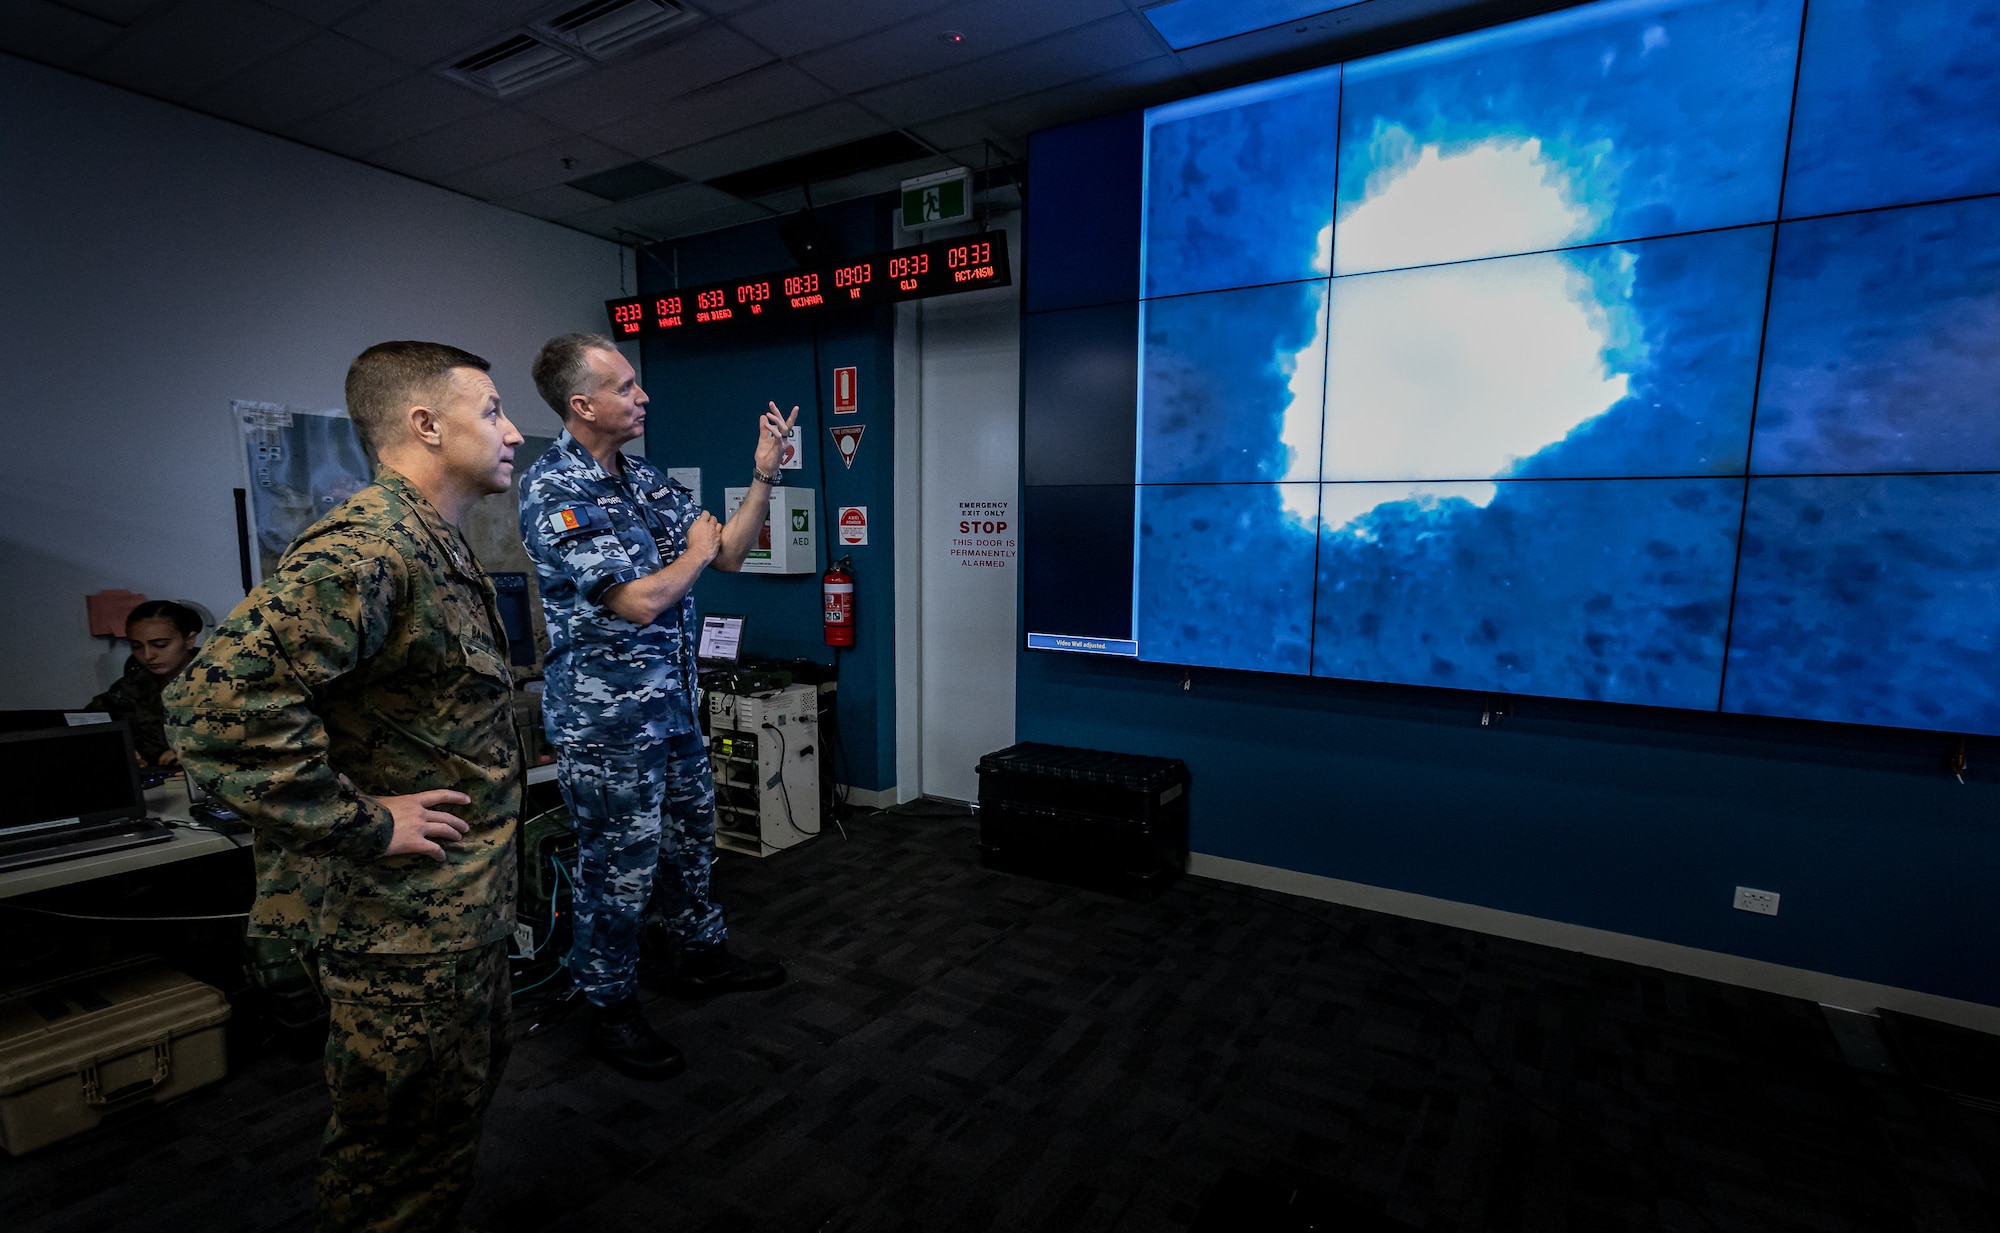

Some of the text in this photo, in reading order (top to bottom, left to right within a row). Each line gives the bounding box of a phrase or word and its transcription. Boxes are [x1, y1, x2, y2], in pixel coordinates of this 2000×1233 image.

[890, 254, 928, 278] 09:33
[955, 266, 994, 282] ACT/NSW
[836, 264, 871, 287] 09:03
[738, 282, 769, 303] 07:33
[785, 274, 818, 295] 08:33
[698, 290, 725, 309] 16:33
[850, 288, 861, 299] NT
[656, 297, 682, 315] 13:33
[960, 521, 1008, 534] STOP
[793, 537, 809, 546] AED
[950, 549, 1016, 558] PERMANENTLY
[961, 560, 1005, 568] ALARMED
[1056, 639, 1071, 647] Video
